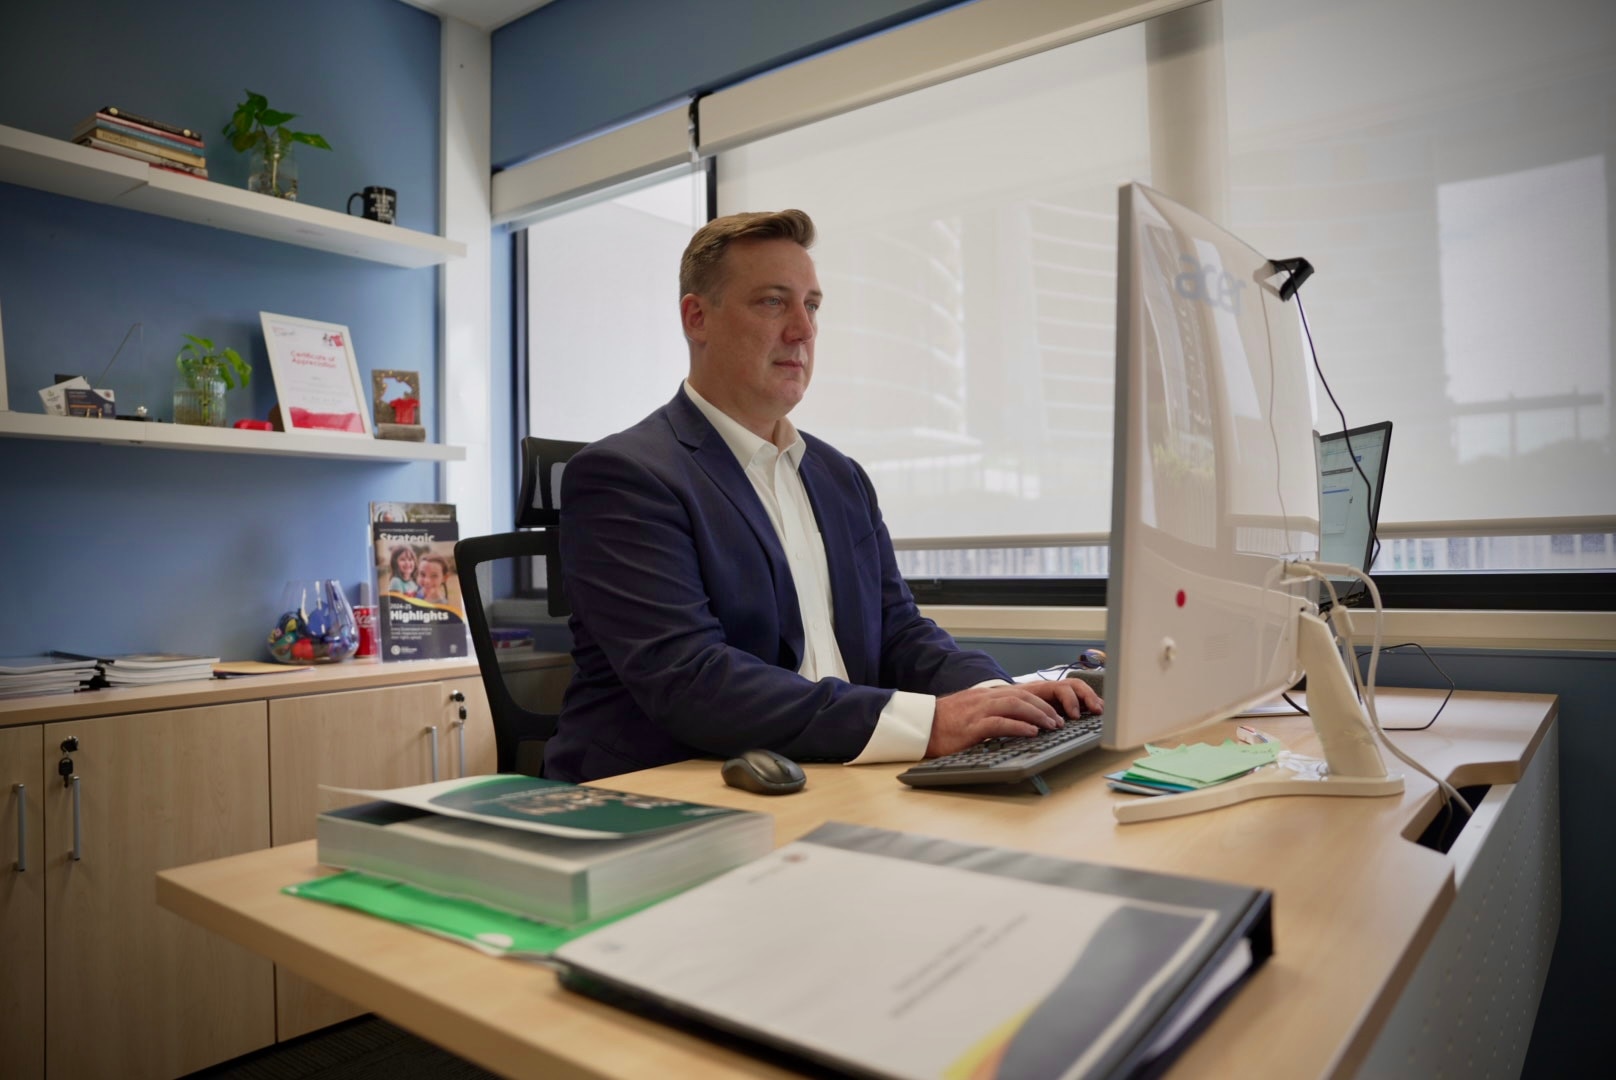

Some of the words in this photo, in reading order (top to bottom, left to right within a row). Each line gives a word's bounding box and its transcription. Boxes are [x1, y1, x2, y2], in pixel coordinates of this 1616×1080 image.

[1174, 253, 1248, 315] acer
[290, 350, 327, 361] Certificate
[291, 357, 337, 368] Appreciation
[379, 532, 435, 543] Strategic
[390, 609, 449, 624] Highlights
